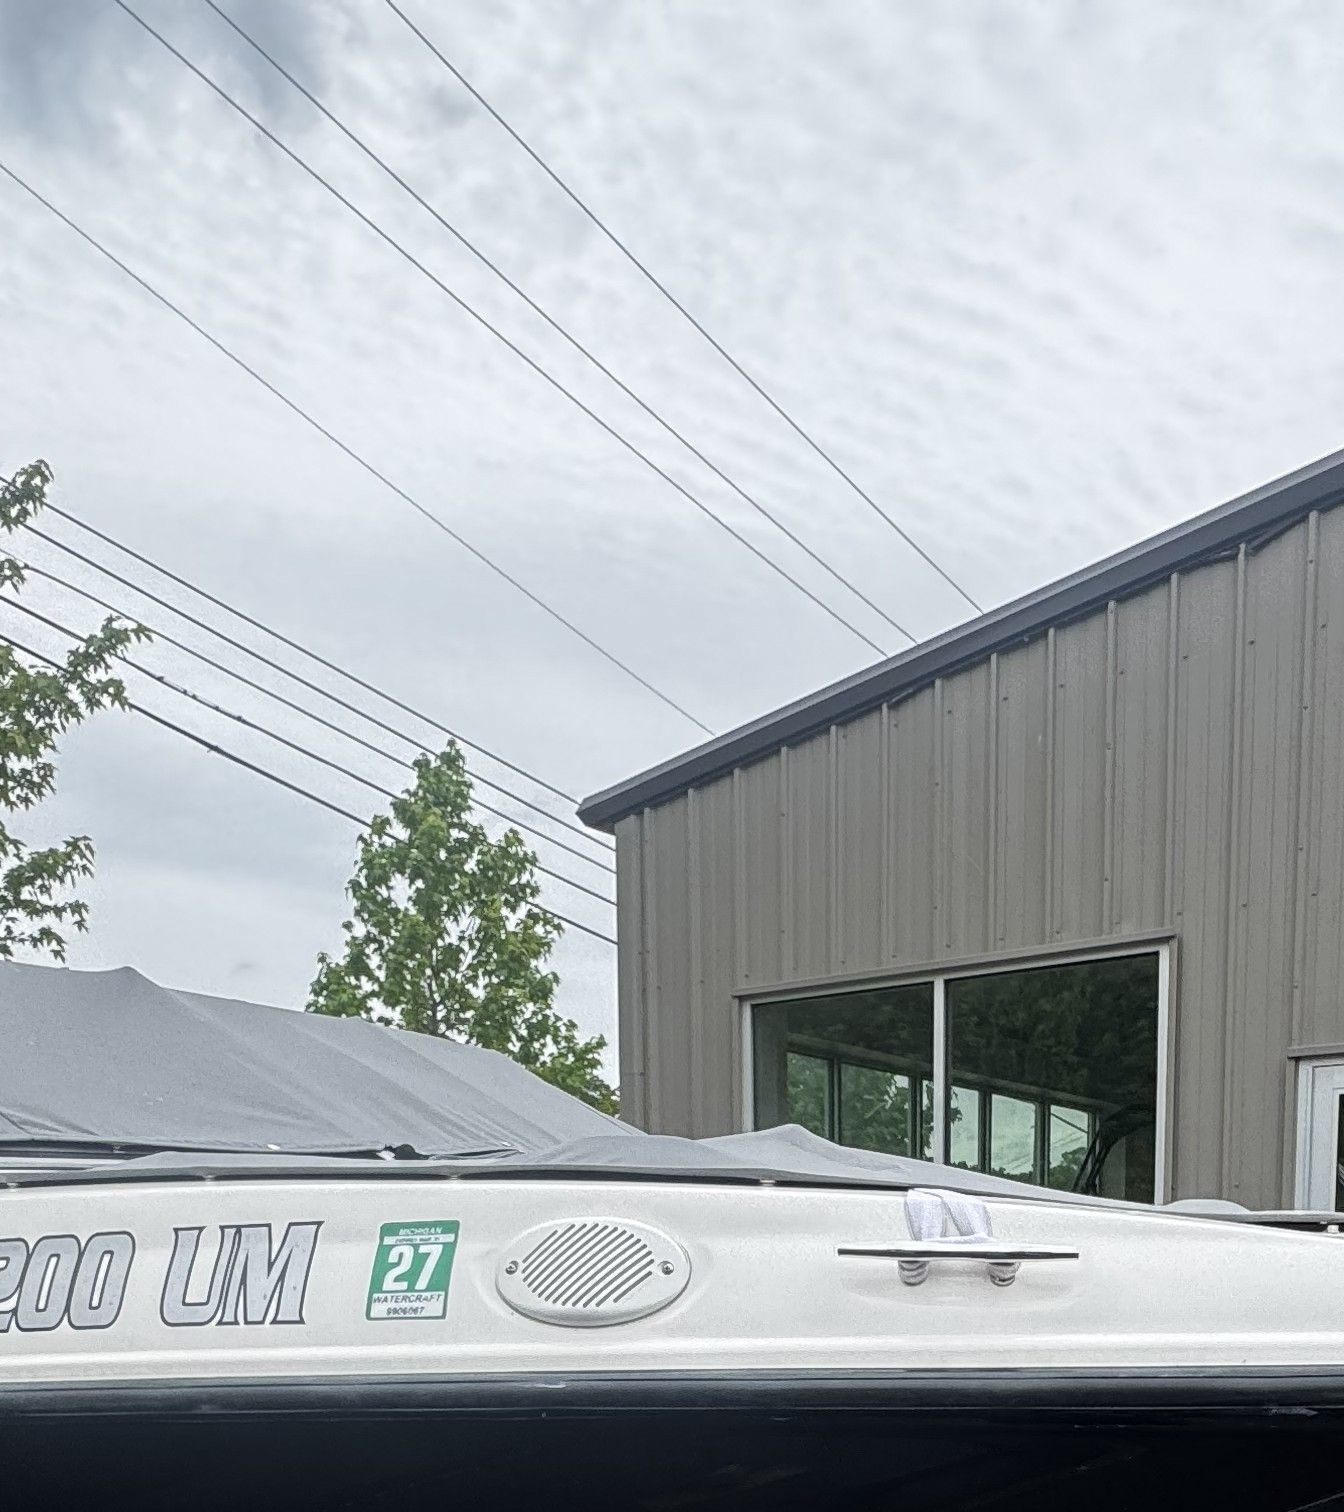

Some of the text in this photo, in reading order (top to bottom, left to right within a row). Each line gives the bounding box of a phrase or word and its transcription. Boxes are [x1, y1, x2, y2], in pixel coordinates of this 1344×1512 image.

[398, 1226, 443, 1236] MICHIGAN
[160, 1221, 325, 1327] UM
[382, 1244, 443, 1291] 27
[372, 1294, 442, 1304] WATERCRAFT
